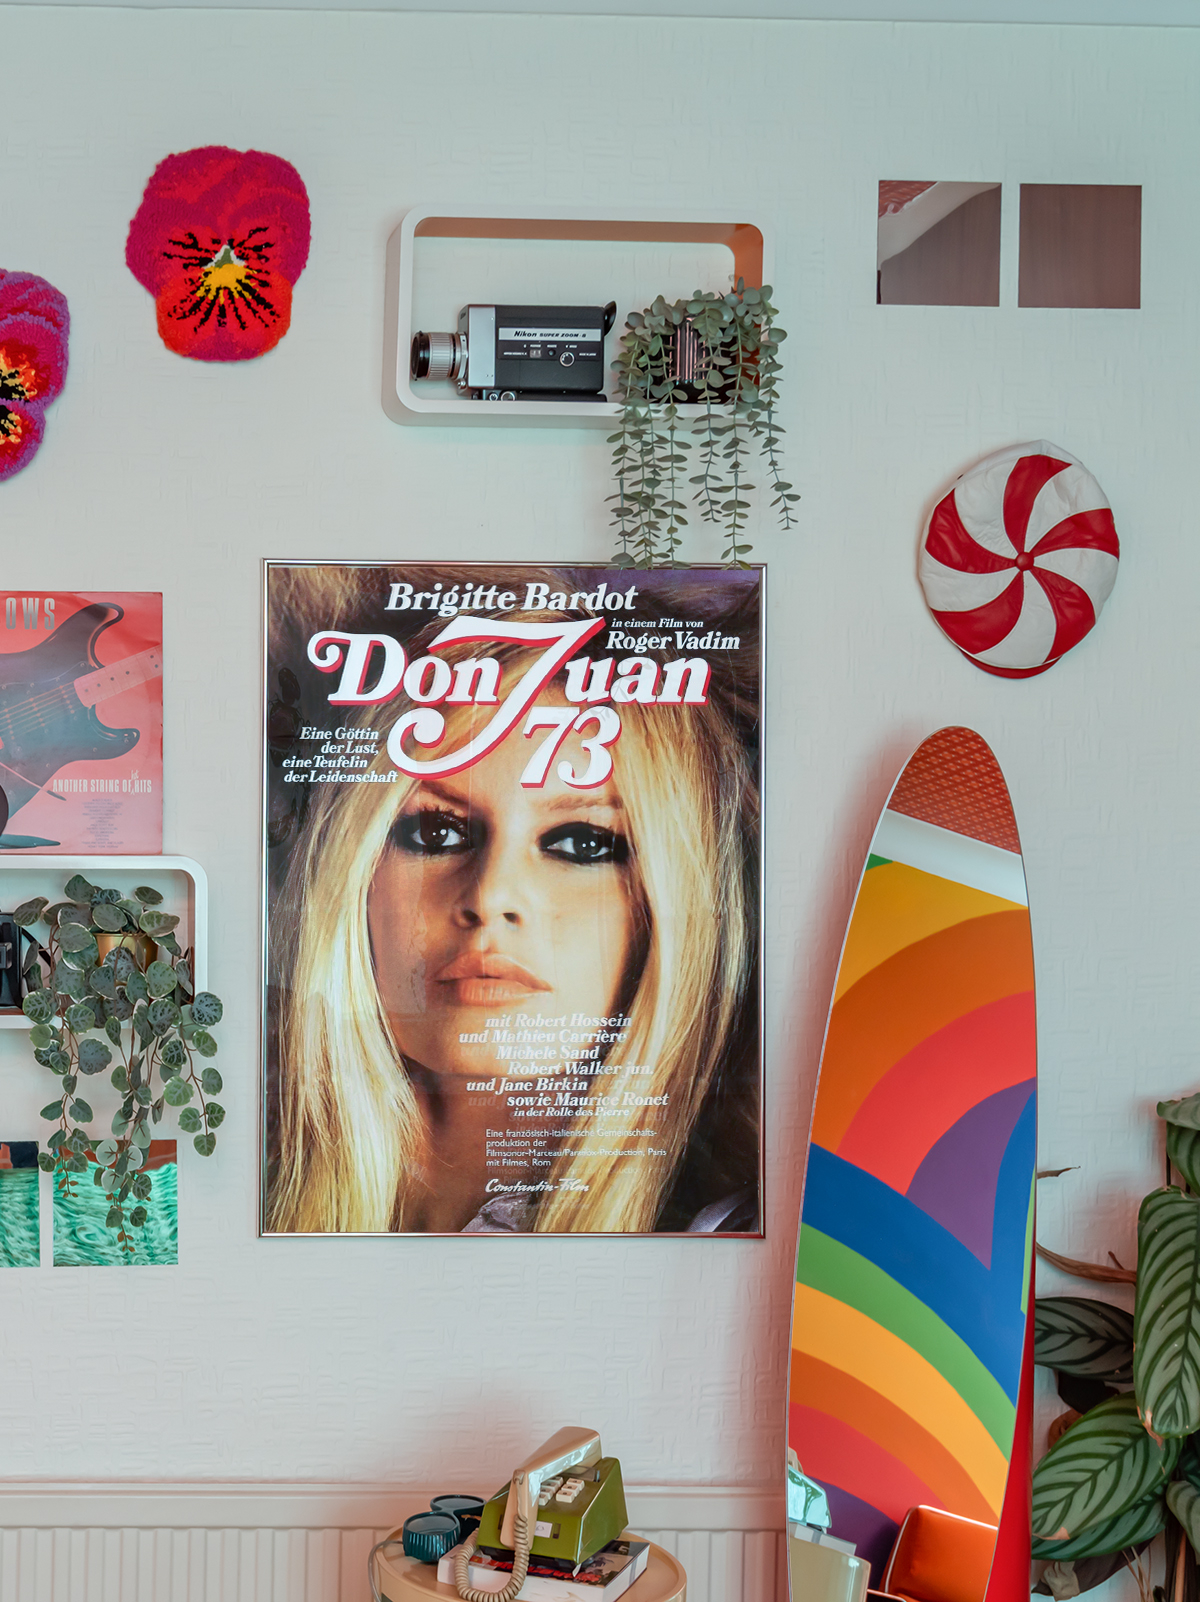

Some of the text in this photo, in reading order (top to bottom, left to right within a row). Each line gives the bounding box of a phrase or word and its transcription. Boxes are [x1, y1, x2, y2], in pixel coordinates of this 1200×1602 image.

[514, 330, 537, 338] Nikon
[384, 583, 638, 617] Brigitte Bardot
[611, 618, 623, 628] in
[624, 618, 657, 628] einem
[658, 618, 683, 628] Film
[605, 630, 741, 654] Roger Vadim
[307, 616, 713, 780] Don Juan
[300, 726, 379, 740] Eine Göttin
[321, 740, 379, 756] der Lust,
[519, 706, 622, 789] 73
[282, 755, 368, 768] eine Teufelin
[284, 769, 399, 783] der Leidenschaft
[52, 779, 152, 793] ANOTHER STRING OF HITS
[484, 1013, 632, 1028] mit Robert Hossein
[459, 1029, 627, 1044] und Mathieu Carrière
[495, 1045, 600, 1060] Michele Sand
[507, 1061, 655, 1079] Robert Walker jun.
[466, 1077, 588, 1095] und Jane Birkin
[506, 1092, 670, 1107] sowie Maurice Ronet
[513, 1106, 630, 1117] in der Rolle des Pierre
[486, 1128, 658, 1138] Eine französisch-italienische Gemeinschafts-
[486, 1139, 547, 1149] produktion der
[647, 1147, 667, 1156] Paris
[502, 1158, 530, 1167] Filmes,
[532, 1158, 552, 1166] Rom
[485, 1178, 590, 1193] Constantin-Film
